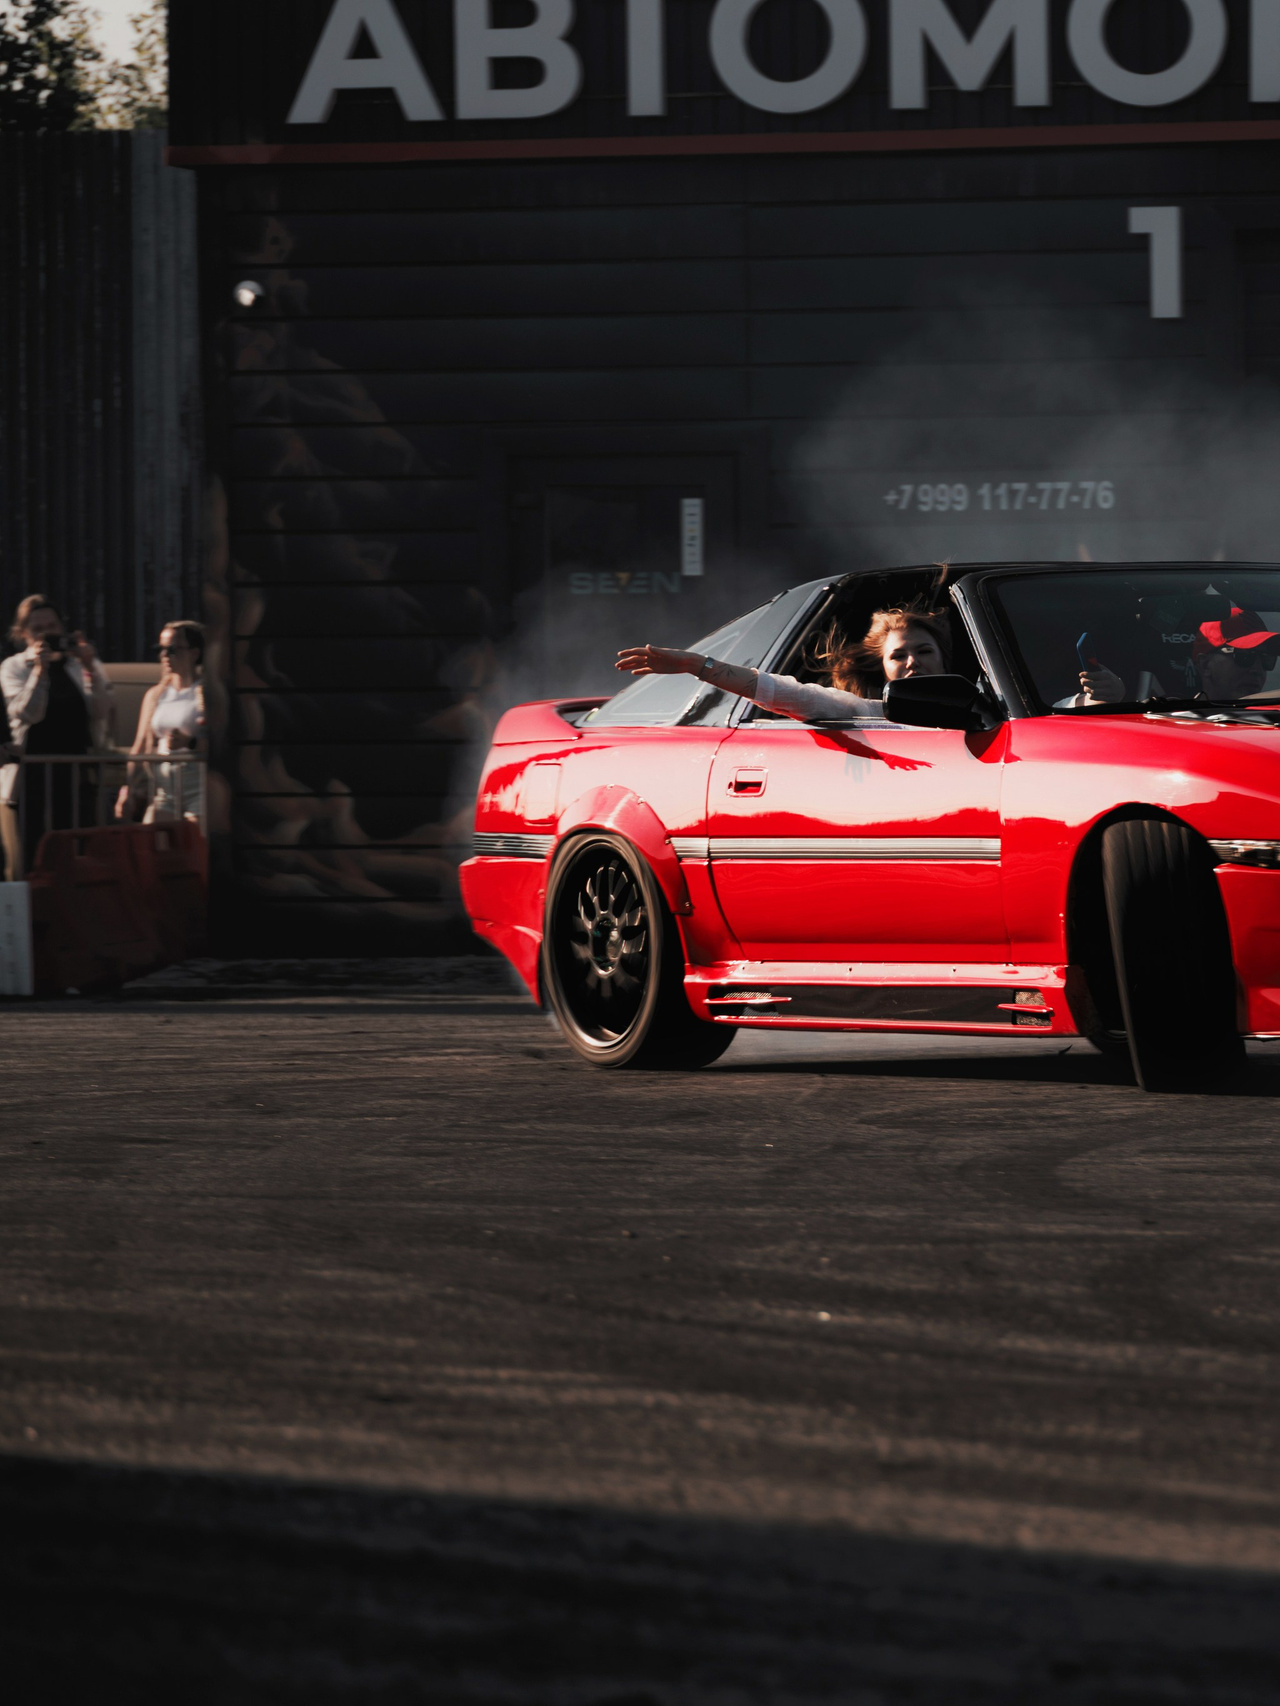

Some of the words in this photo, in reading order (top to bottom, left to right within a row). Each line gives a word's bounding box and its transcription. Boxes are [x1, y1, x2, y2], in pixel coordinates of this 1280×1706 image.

[1128, 206, 1182, 319] 1
[917, 483, 969, 512] 999
[977, 480, 1115, 510] 117-77-76
[569, 571, 681, 594] SEVEN
